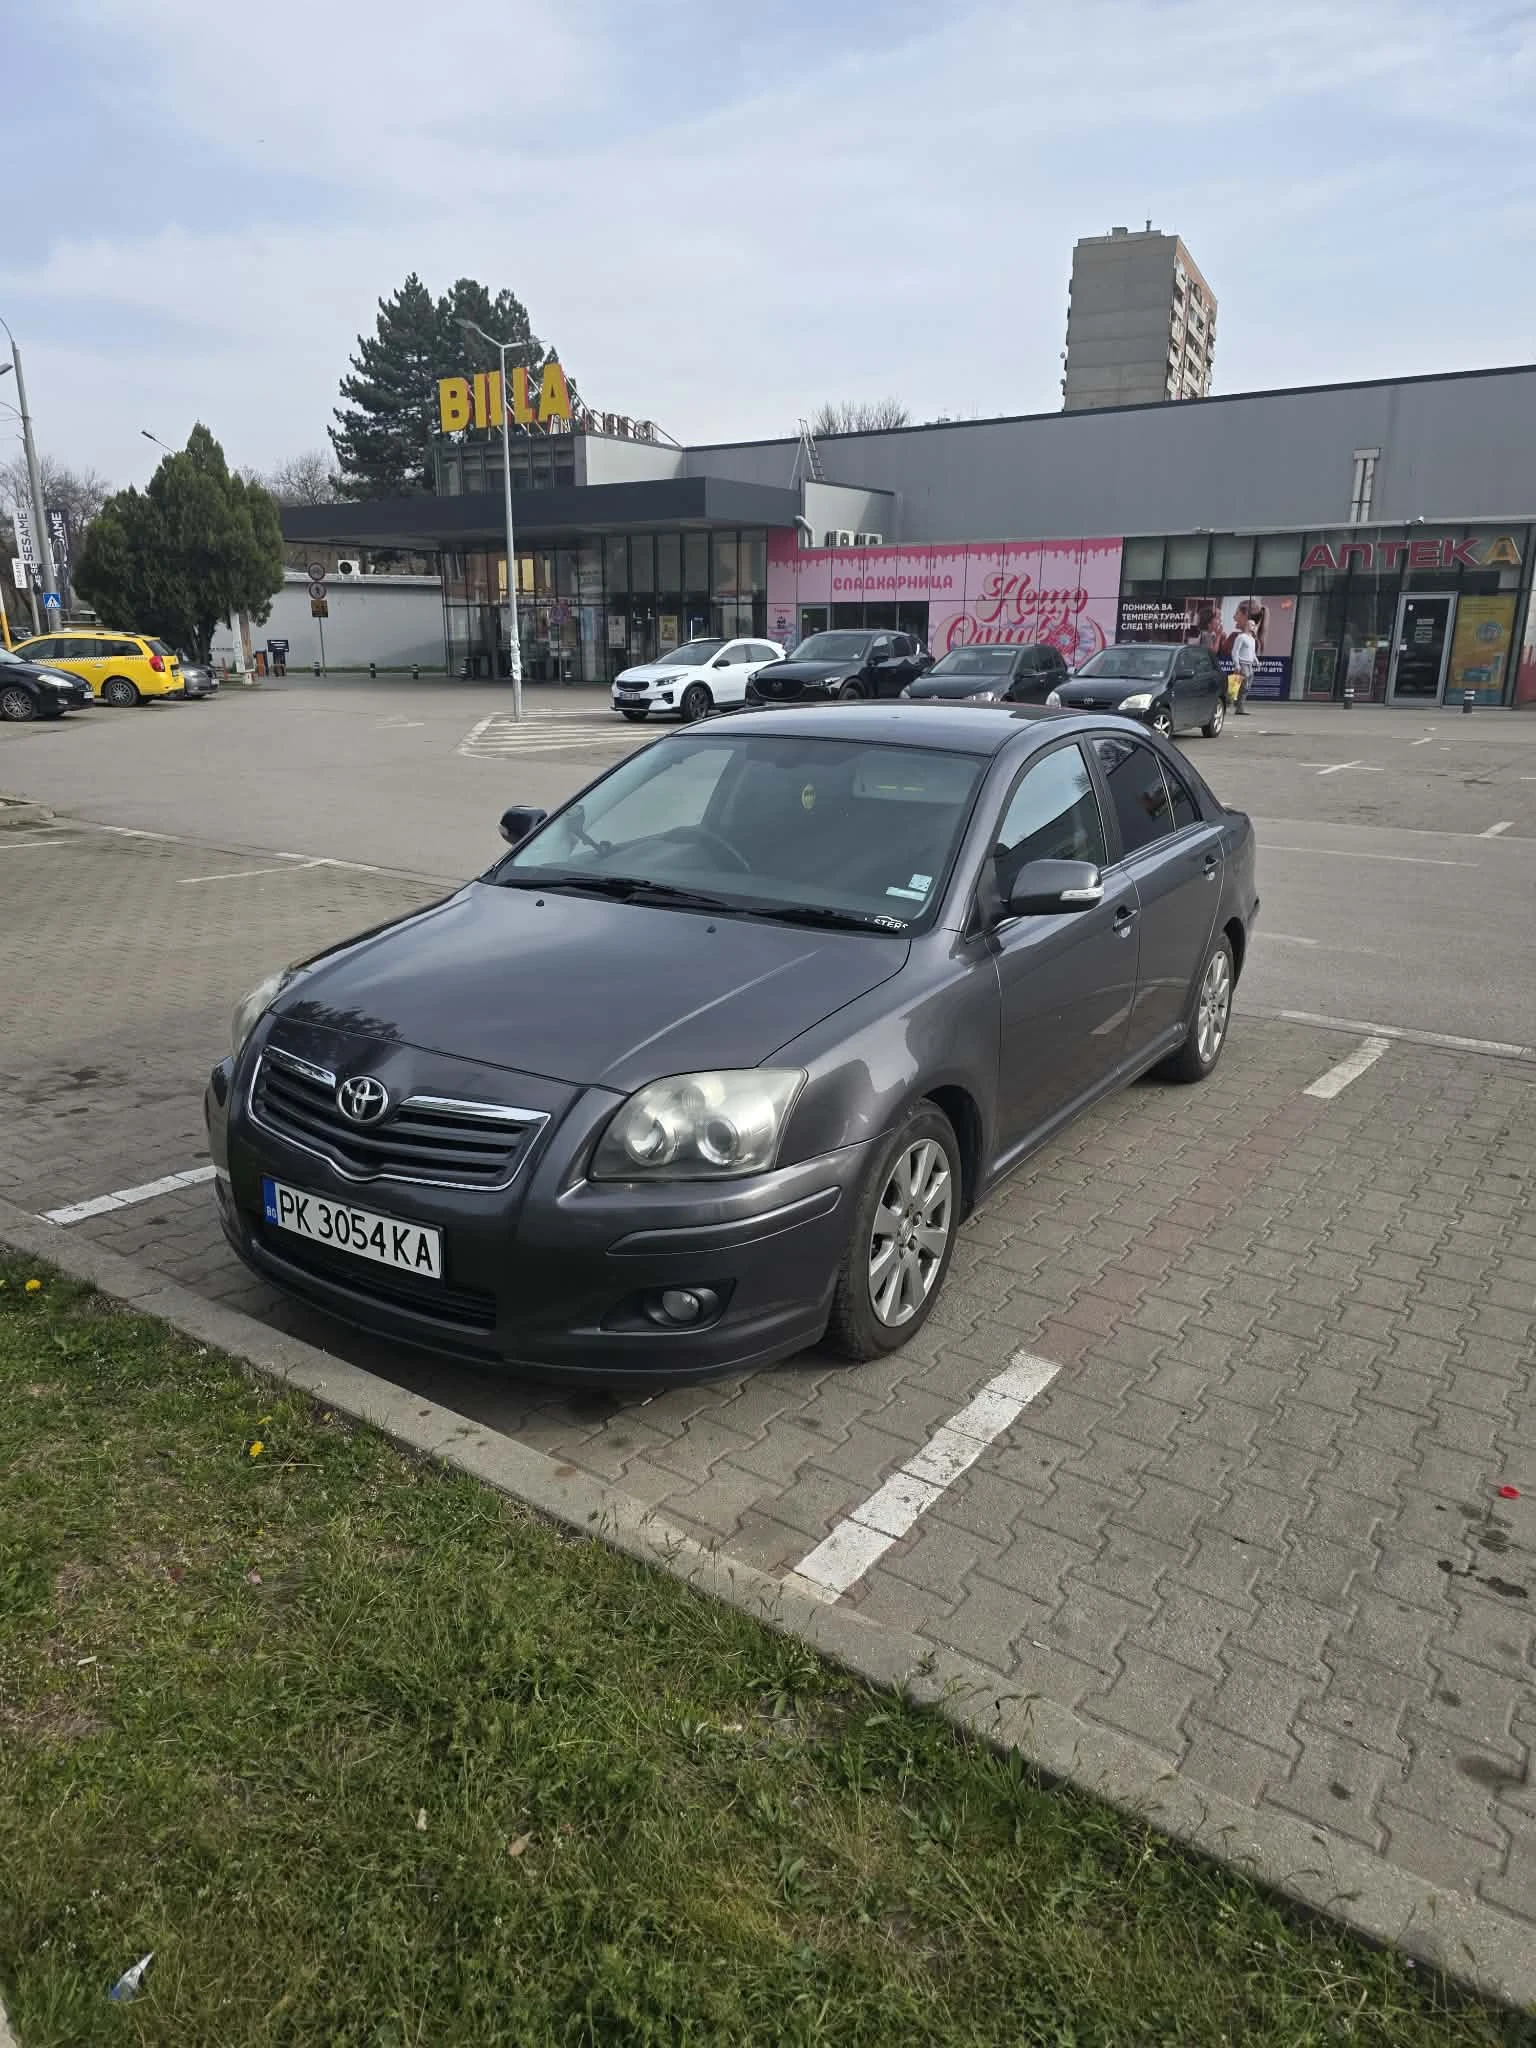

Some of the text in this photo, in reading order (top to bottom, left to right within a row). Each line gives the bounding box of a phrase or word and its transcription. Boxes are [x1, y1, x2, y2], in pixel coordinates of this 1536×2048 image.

[439, 363, 573, 432] BILLA
[17, 511, 34, 561] SESAME
[1301, 537, 1523, 571] АПТЕКА
[833, 575, 953, 591] СЛАДКАРНИЦА
[1121, 622, 1143, 631] СЛЕД
[279, 1189, 434, 1272] PK 3054 KA
